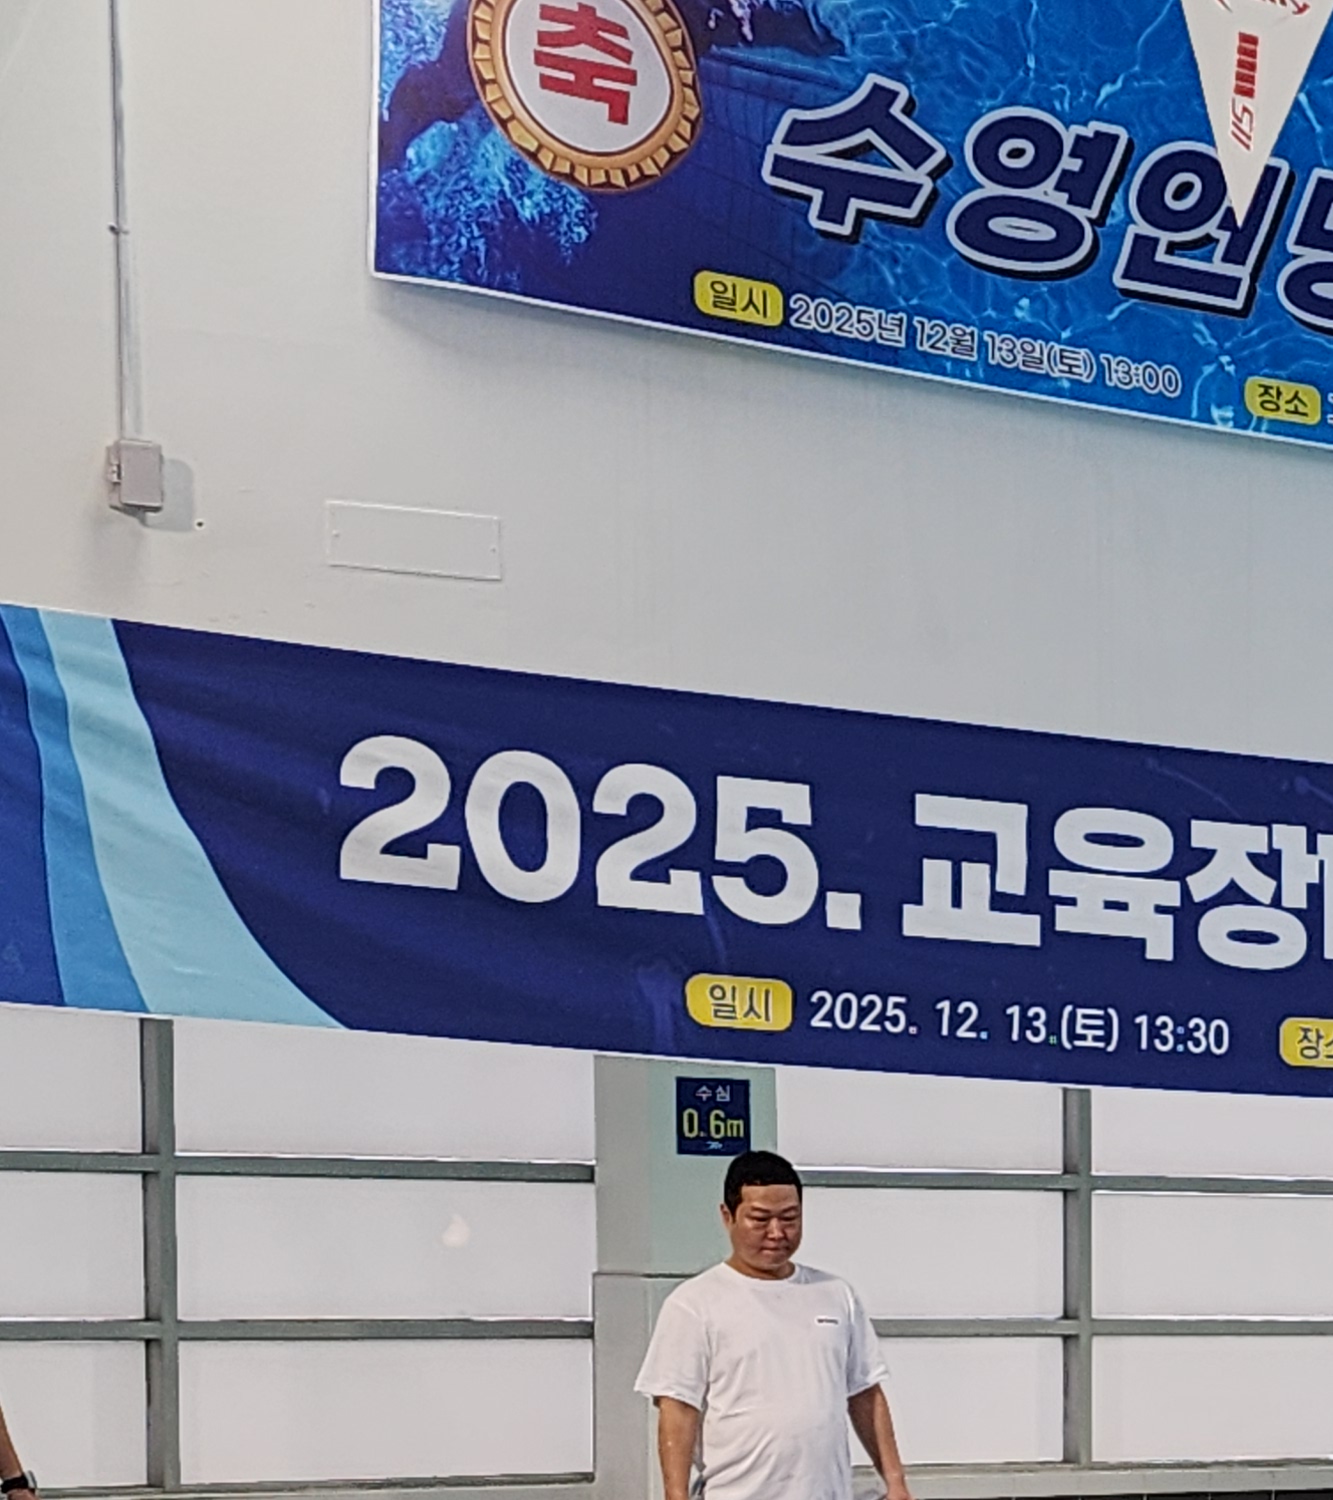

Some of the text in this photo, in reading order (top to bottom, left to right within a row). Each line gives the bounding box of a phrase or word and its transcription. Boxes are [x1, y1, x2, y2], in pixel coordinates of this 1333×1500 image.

[534, 2, 638, 125] 축
[707, 278, 1182, 397] 일시 2025년 12월 13일(토) 13:00
[1256, 382, 1311, 419] 장소
[339, 733, 863, 931] 2025.
[707, 983, 773, 1024] 일시
[809, 988, 919, 1037] 2025.
[934, 998, 989, 1041] 12.
[1132, 1012, 1230, 1057] 13:30
[682, 1107, 744, 1139] 0.6m
[695, 1085, 731, 1102] 수심
